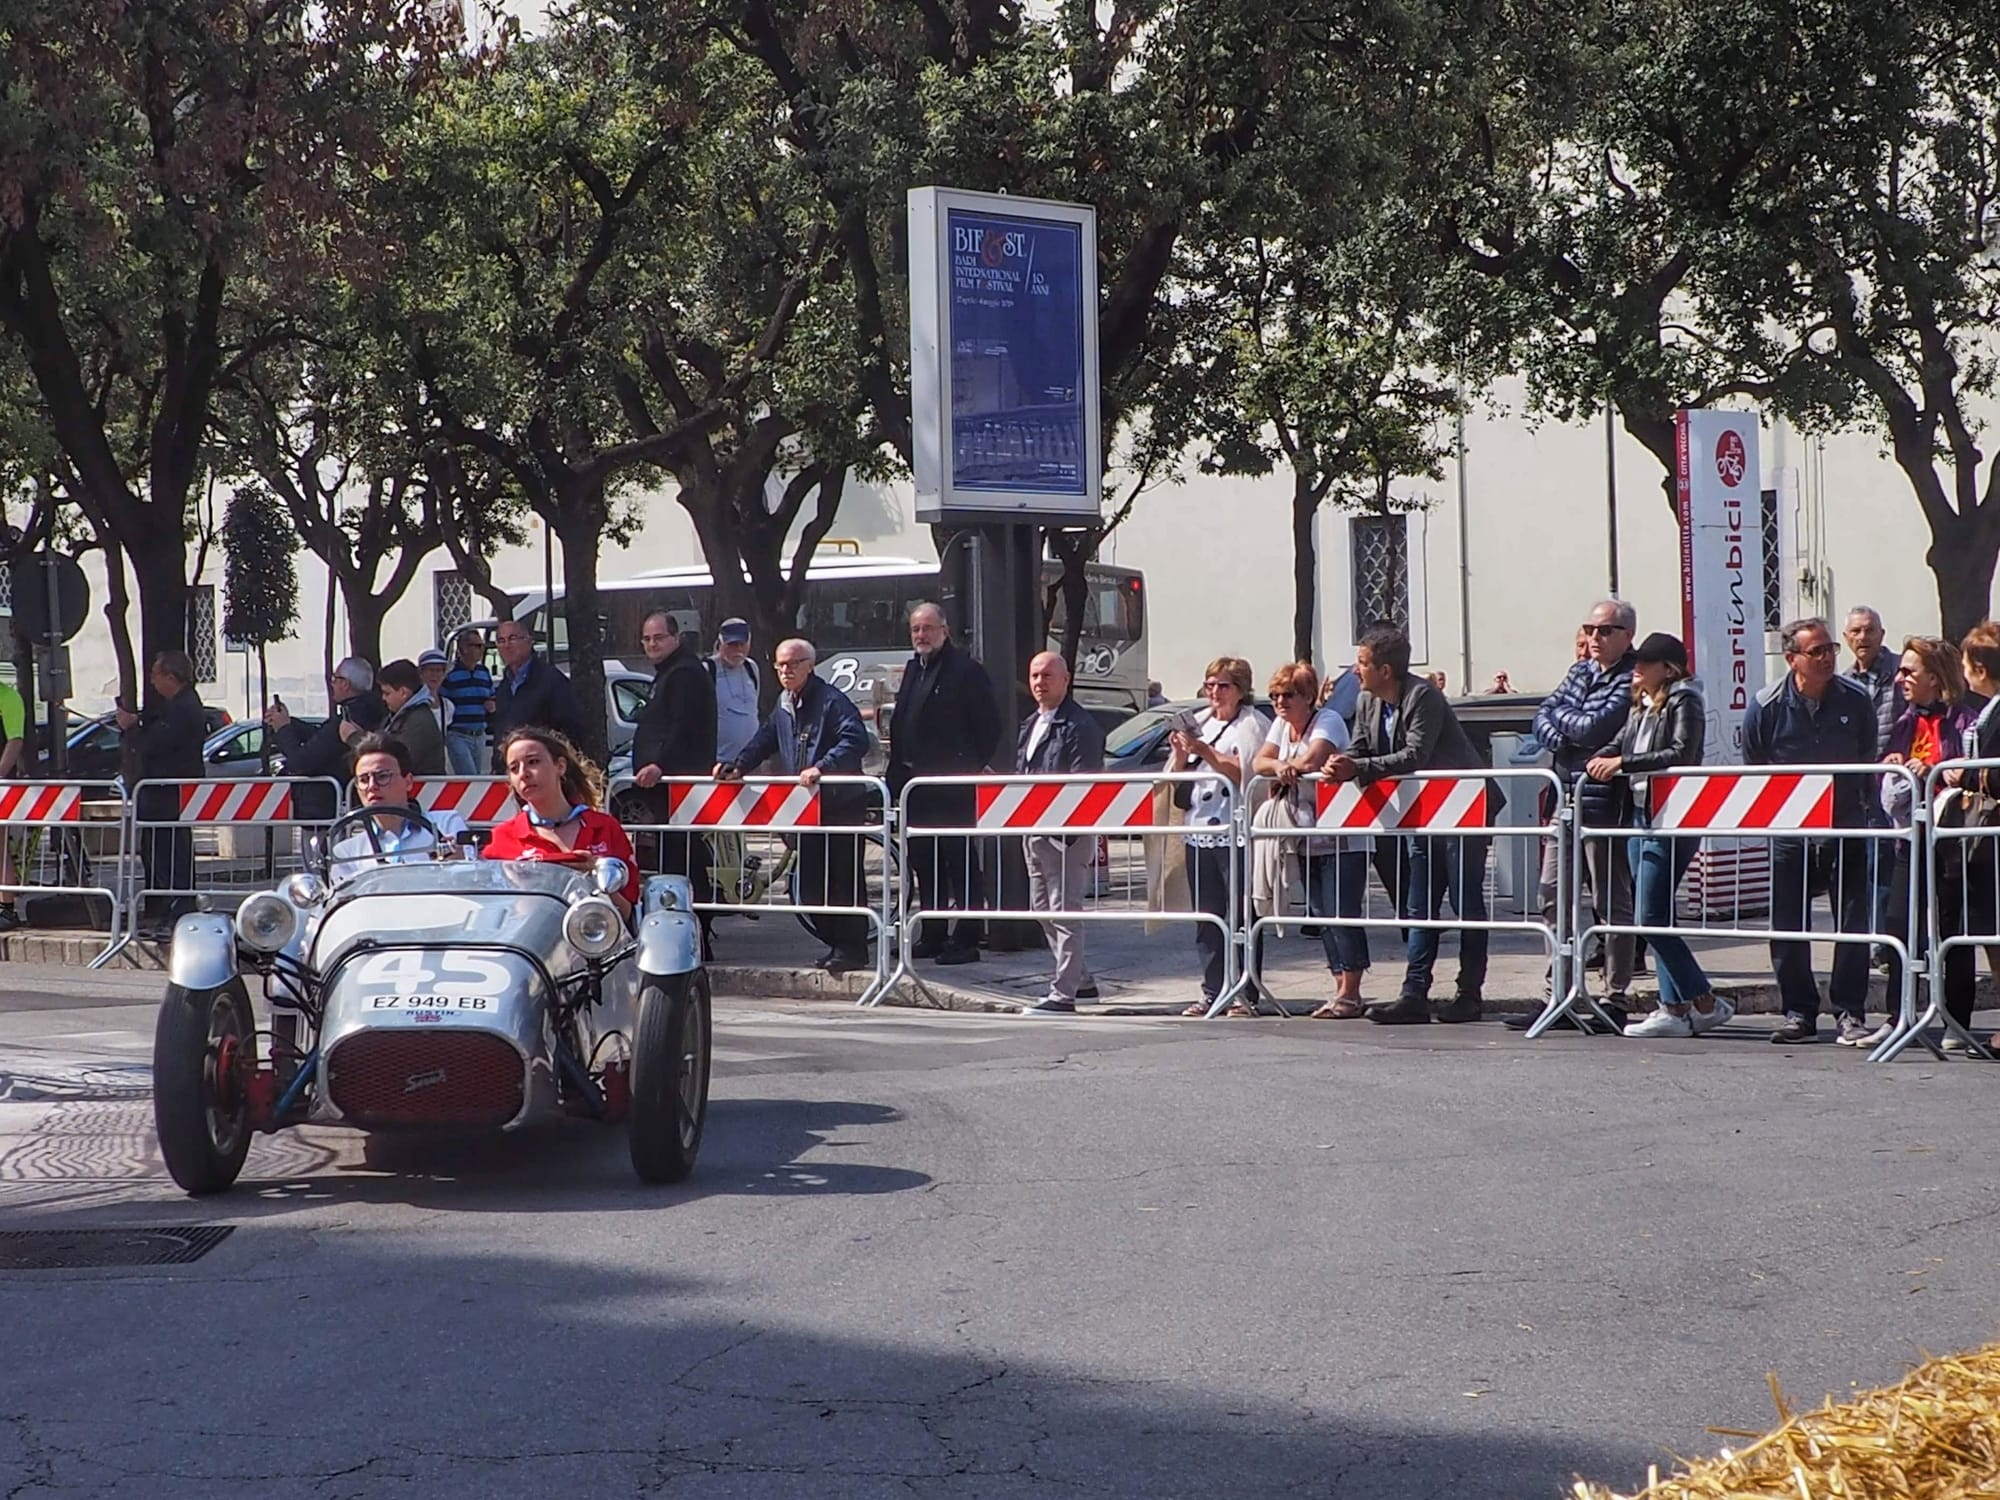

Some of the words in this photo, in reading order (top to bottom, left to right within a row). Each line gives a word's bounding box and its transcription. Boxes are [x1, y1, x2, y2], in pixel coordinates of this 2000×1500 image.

[955, 267, 1020, 282] INTERNATIONAL
[357, 951, 511, 995] 45
[373, 997, 399, 1009] EZ
[408, 996, 448, 1008] 949
[458, 997, 486, 1009] EB
